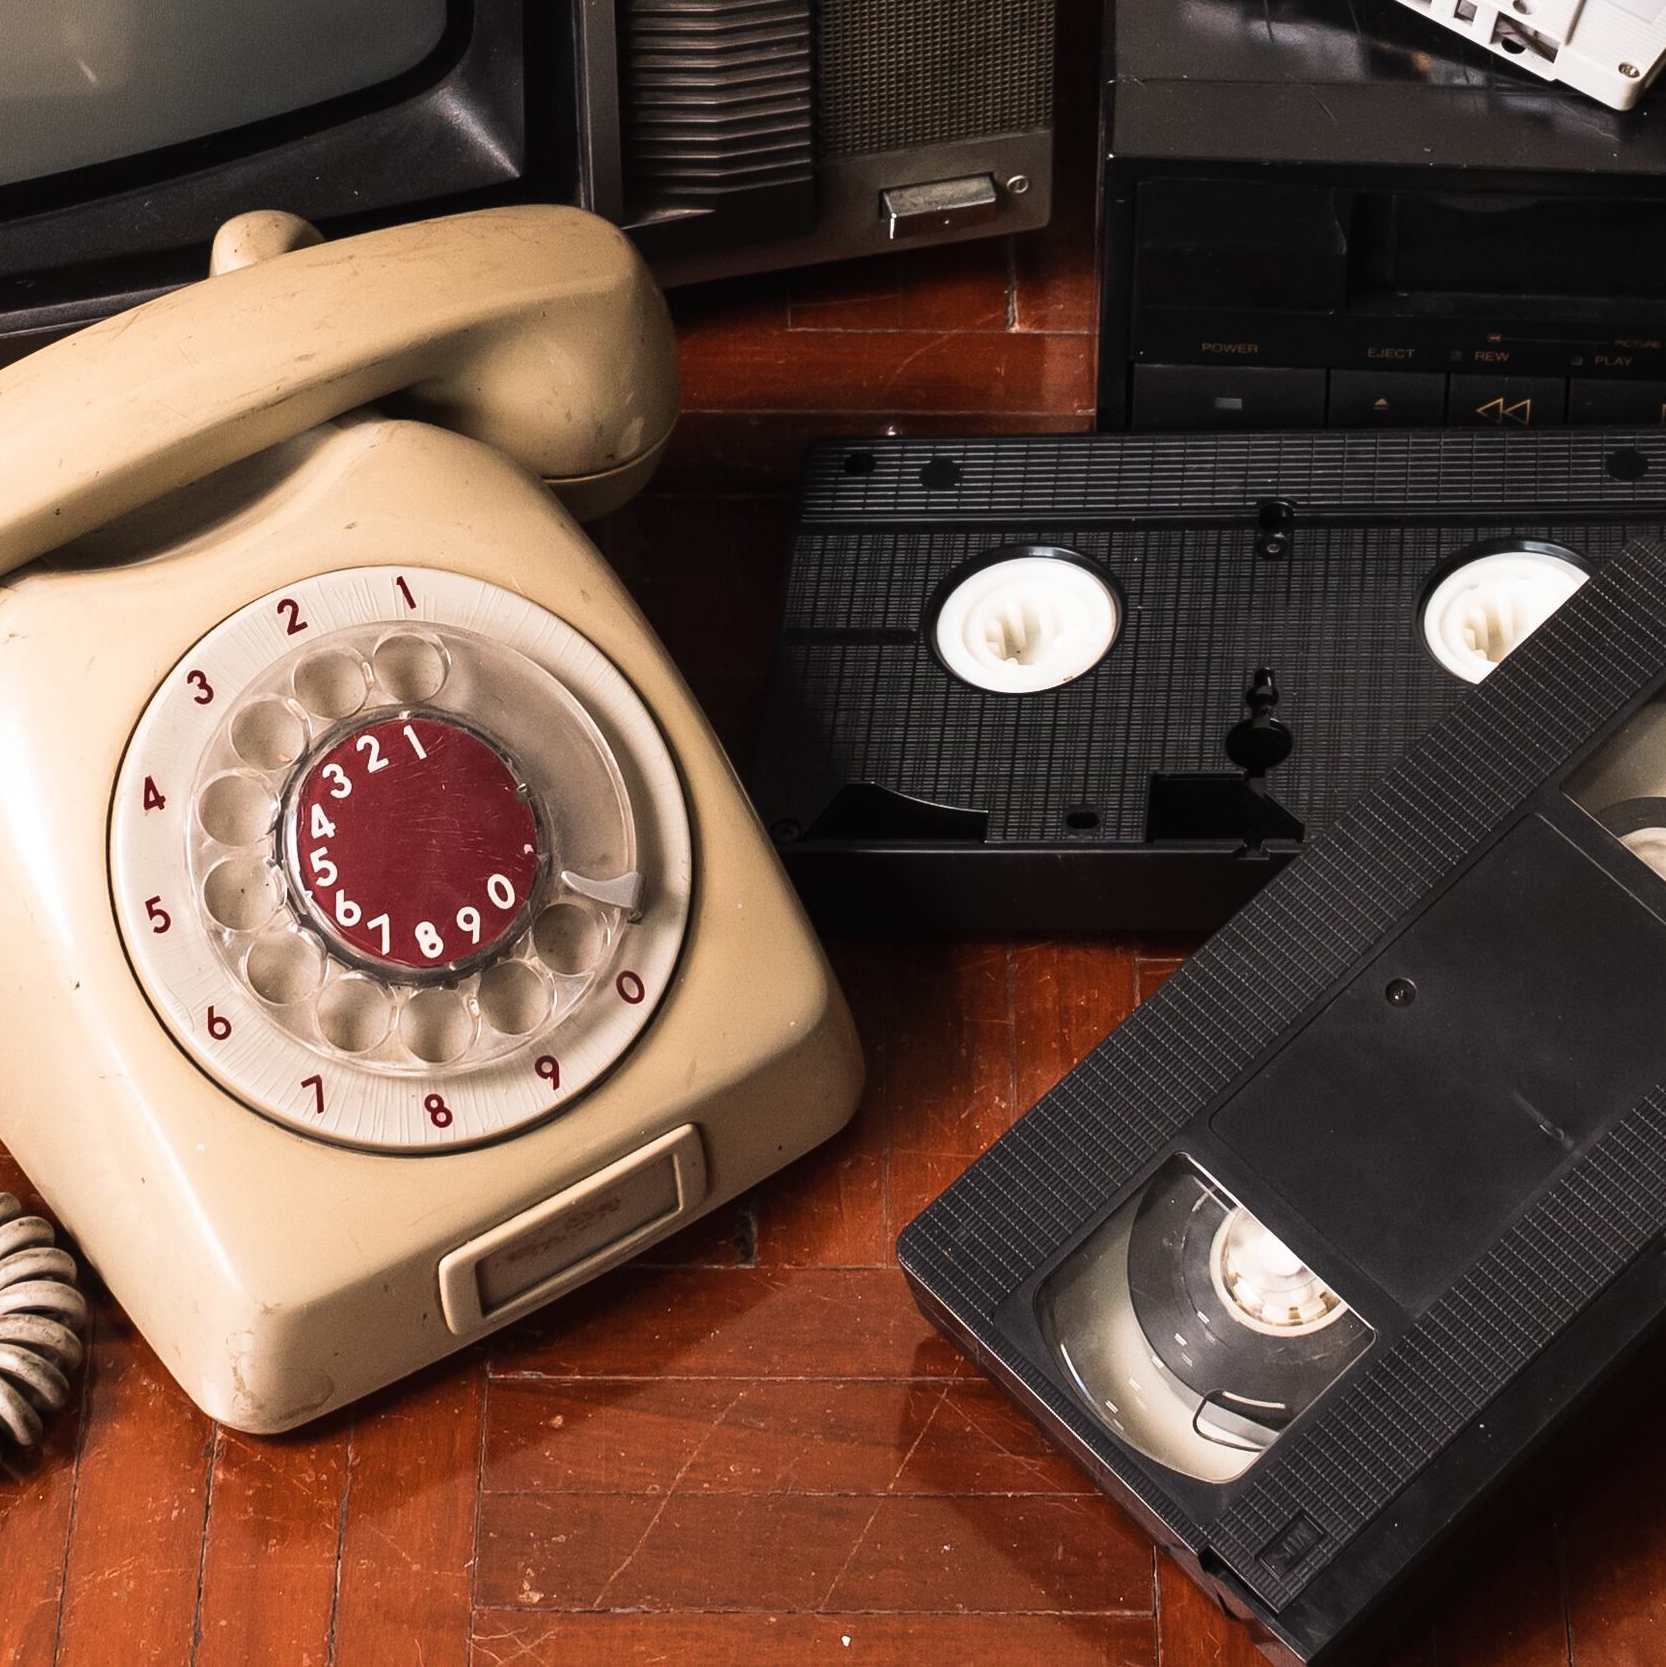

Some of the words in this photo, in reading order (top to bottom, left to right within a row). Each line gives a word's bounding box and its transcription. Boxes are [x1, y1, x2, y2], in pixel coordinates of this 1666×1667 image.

[1201, 341, 1259, 354] POWER
[1367, 347, 1416, 360] EJECT
[1474, 350, 1510, 362] REW
[1595, 355, 1633, 367] PLAY
[395, 576, 417, 609] 1
[277, 598, 308, 635] 2
[187, 670, 215, 705] 3
[356, 735, 389, 773] 2
[403, 725, 427, 760] 1
[142, 776, 166, 811] 4
[322, 763, 352, 800] 3
[310, 804, 336, 840] 4
[309, 847, 337, 887] 5
[336, 890, 362, 927] 6
[487, 874, 515, 910] 0
[145, 895, 172, 934] 5
[456, 906, 481, 943] 9
[367, 913, 392, 955] 7
[415, 921, 444, 958] 8
[615, 970, 645, 1004] 0
[208, 1006, 232, 1041] 6
[535, 1055, 561, 1091] 9
[301, 1075, 325, 1114] 7
[424, 1093, 453, 1129] 8
